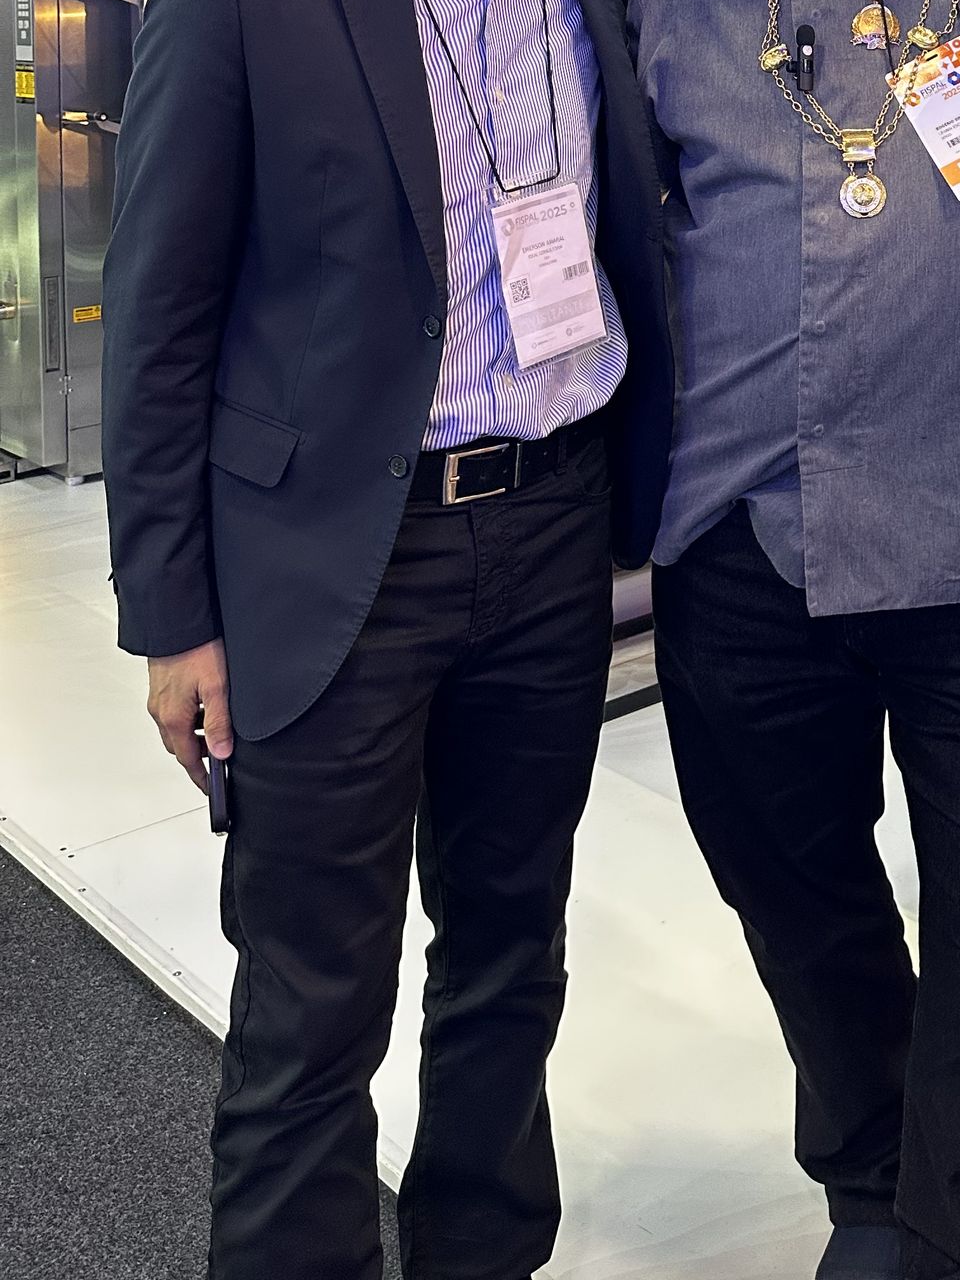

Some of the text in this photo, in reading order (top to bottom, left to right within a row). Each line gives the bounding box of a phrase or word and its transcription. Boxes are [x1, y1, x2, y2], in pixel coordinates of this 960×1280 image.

[919, 79, 947, 98] FISPAL
[514, 212, 539, 225] FISPAL
[540, 204, 568, 222] 2025
